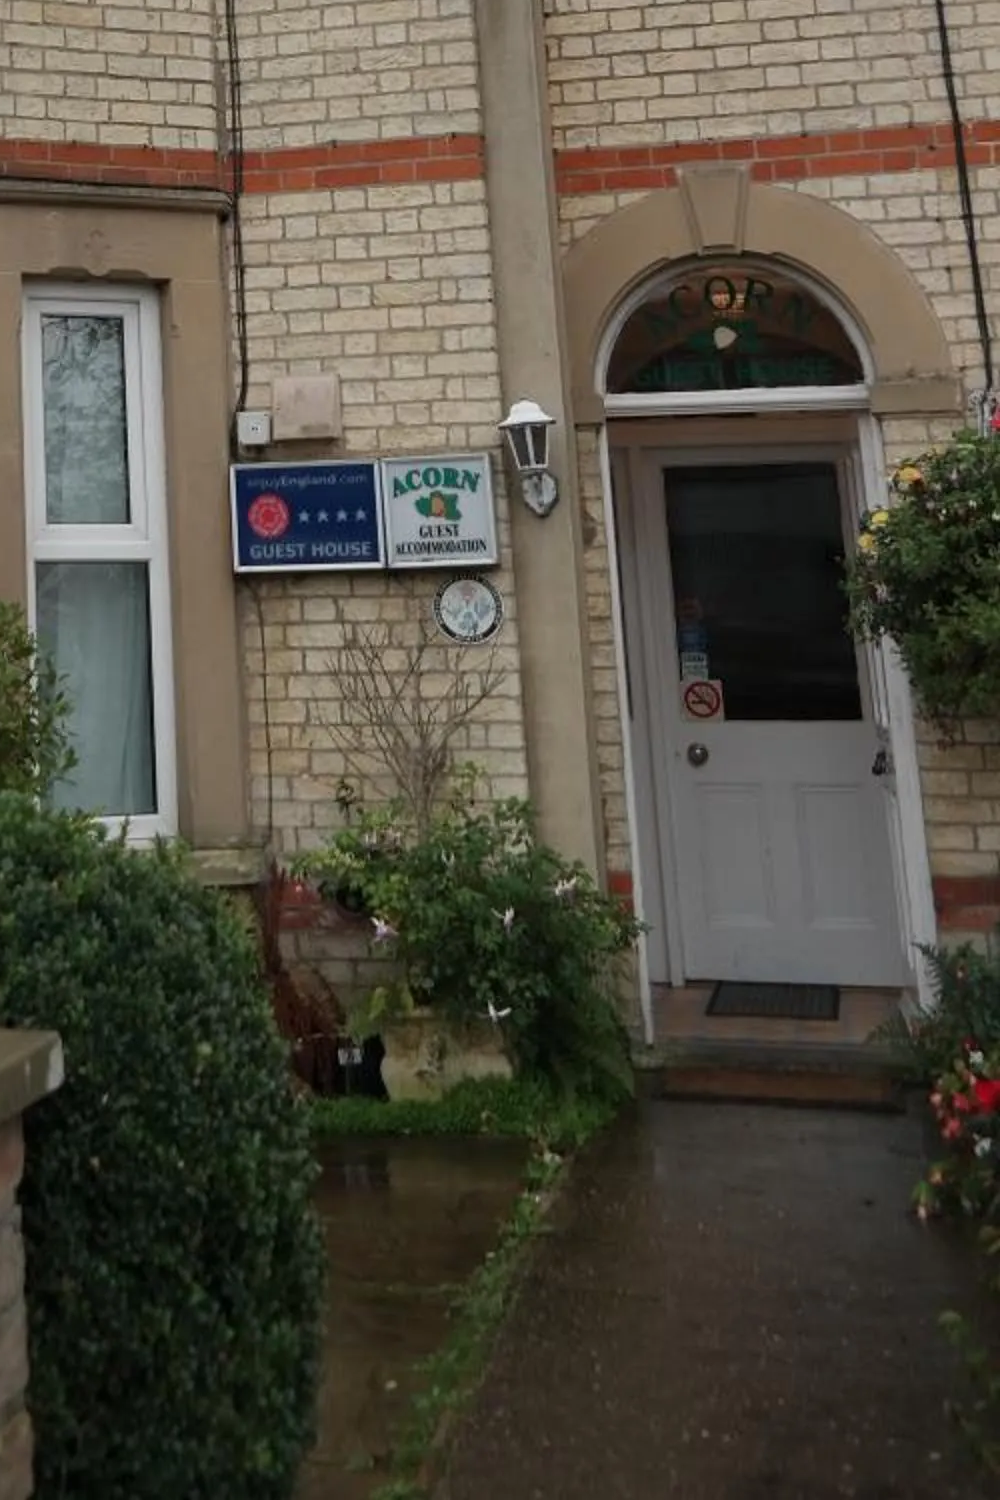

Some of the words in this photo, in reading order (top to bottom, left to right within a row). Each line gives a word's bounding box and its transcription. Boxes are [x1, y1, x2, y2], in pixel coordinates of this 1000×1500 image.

[392, 467, 481, 499] ACORN
[419, 524, 460, 538] GUEST
[249, 542, 305, 559] GUEST
[311, 541, 373, 558] HOUSE
[395, 539, 488, 556] ACCOMMODATION
